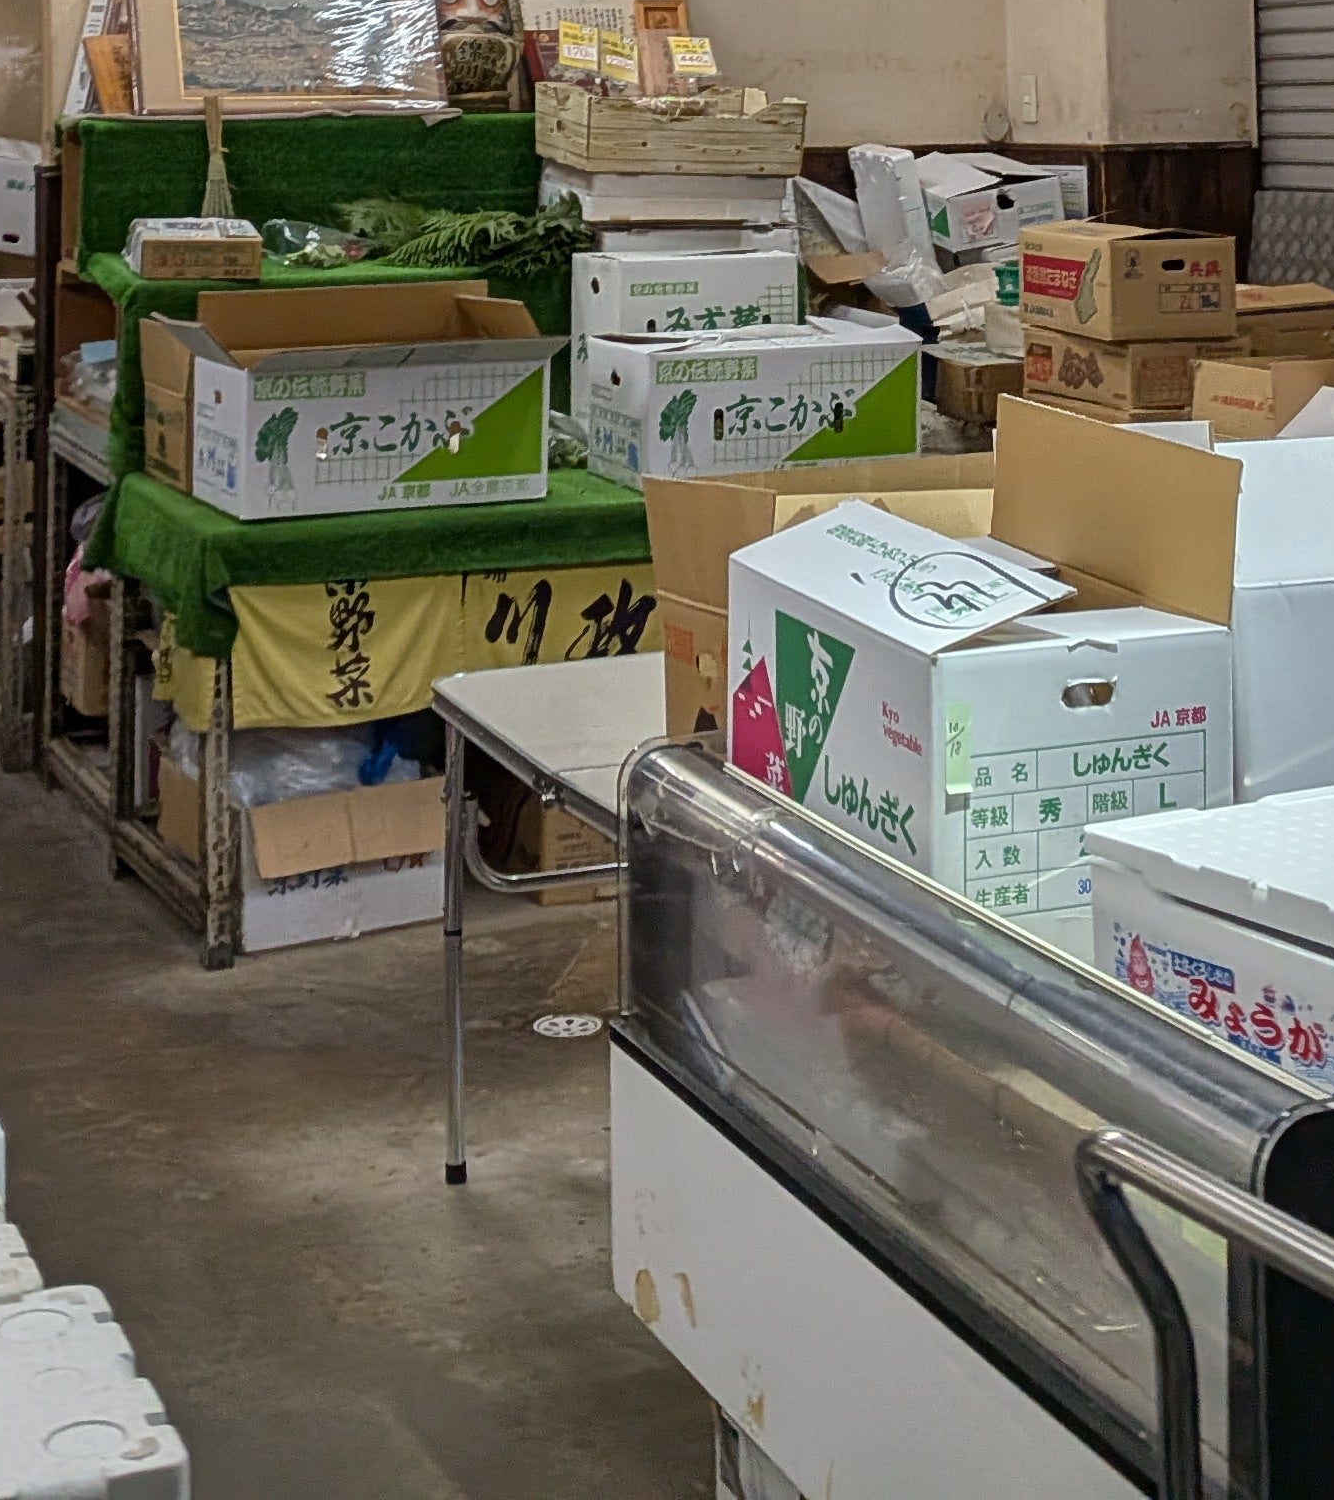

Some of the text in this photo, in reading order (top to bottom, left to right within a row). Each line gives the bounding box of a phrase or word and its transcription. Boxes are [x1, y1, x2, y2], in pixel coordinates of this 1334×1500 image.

[328, 407, 474, 456] 京こかぶ
[726, 388, 857, 436] 京こかぶ
[881, 700, 901, 724] Kyo
[1151, 705, 1207, 729] JA 京都
[881, 723, 923, 757] vegetable
[1073, 742, 1171, 778] しゅんぎく
[823, 754, 917, 856] しゅんぎく
[971, 782, 1177, 829] 等級 秀 階級 L
[975, 845, 1021, 871] 入数
[1188, 978, 1325, 1064] みょうが
